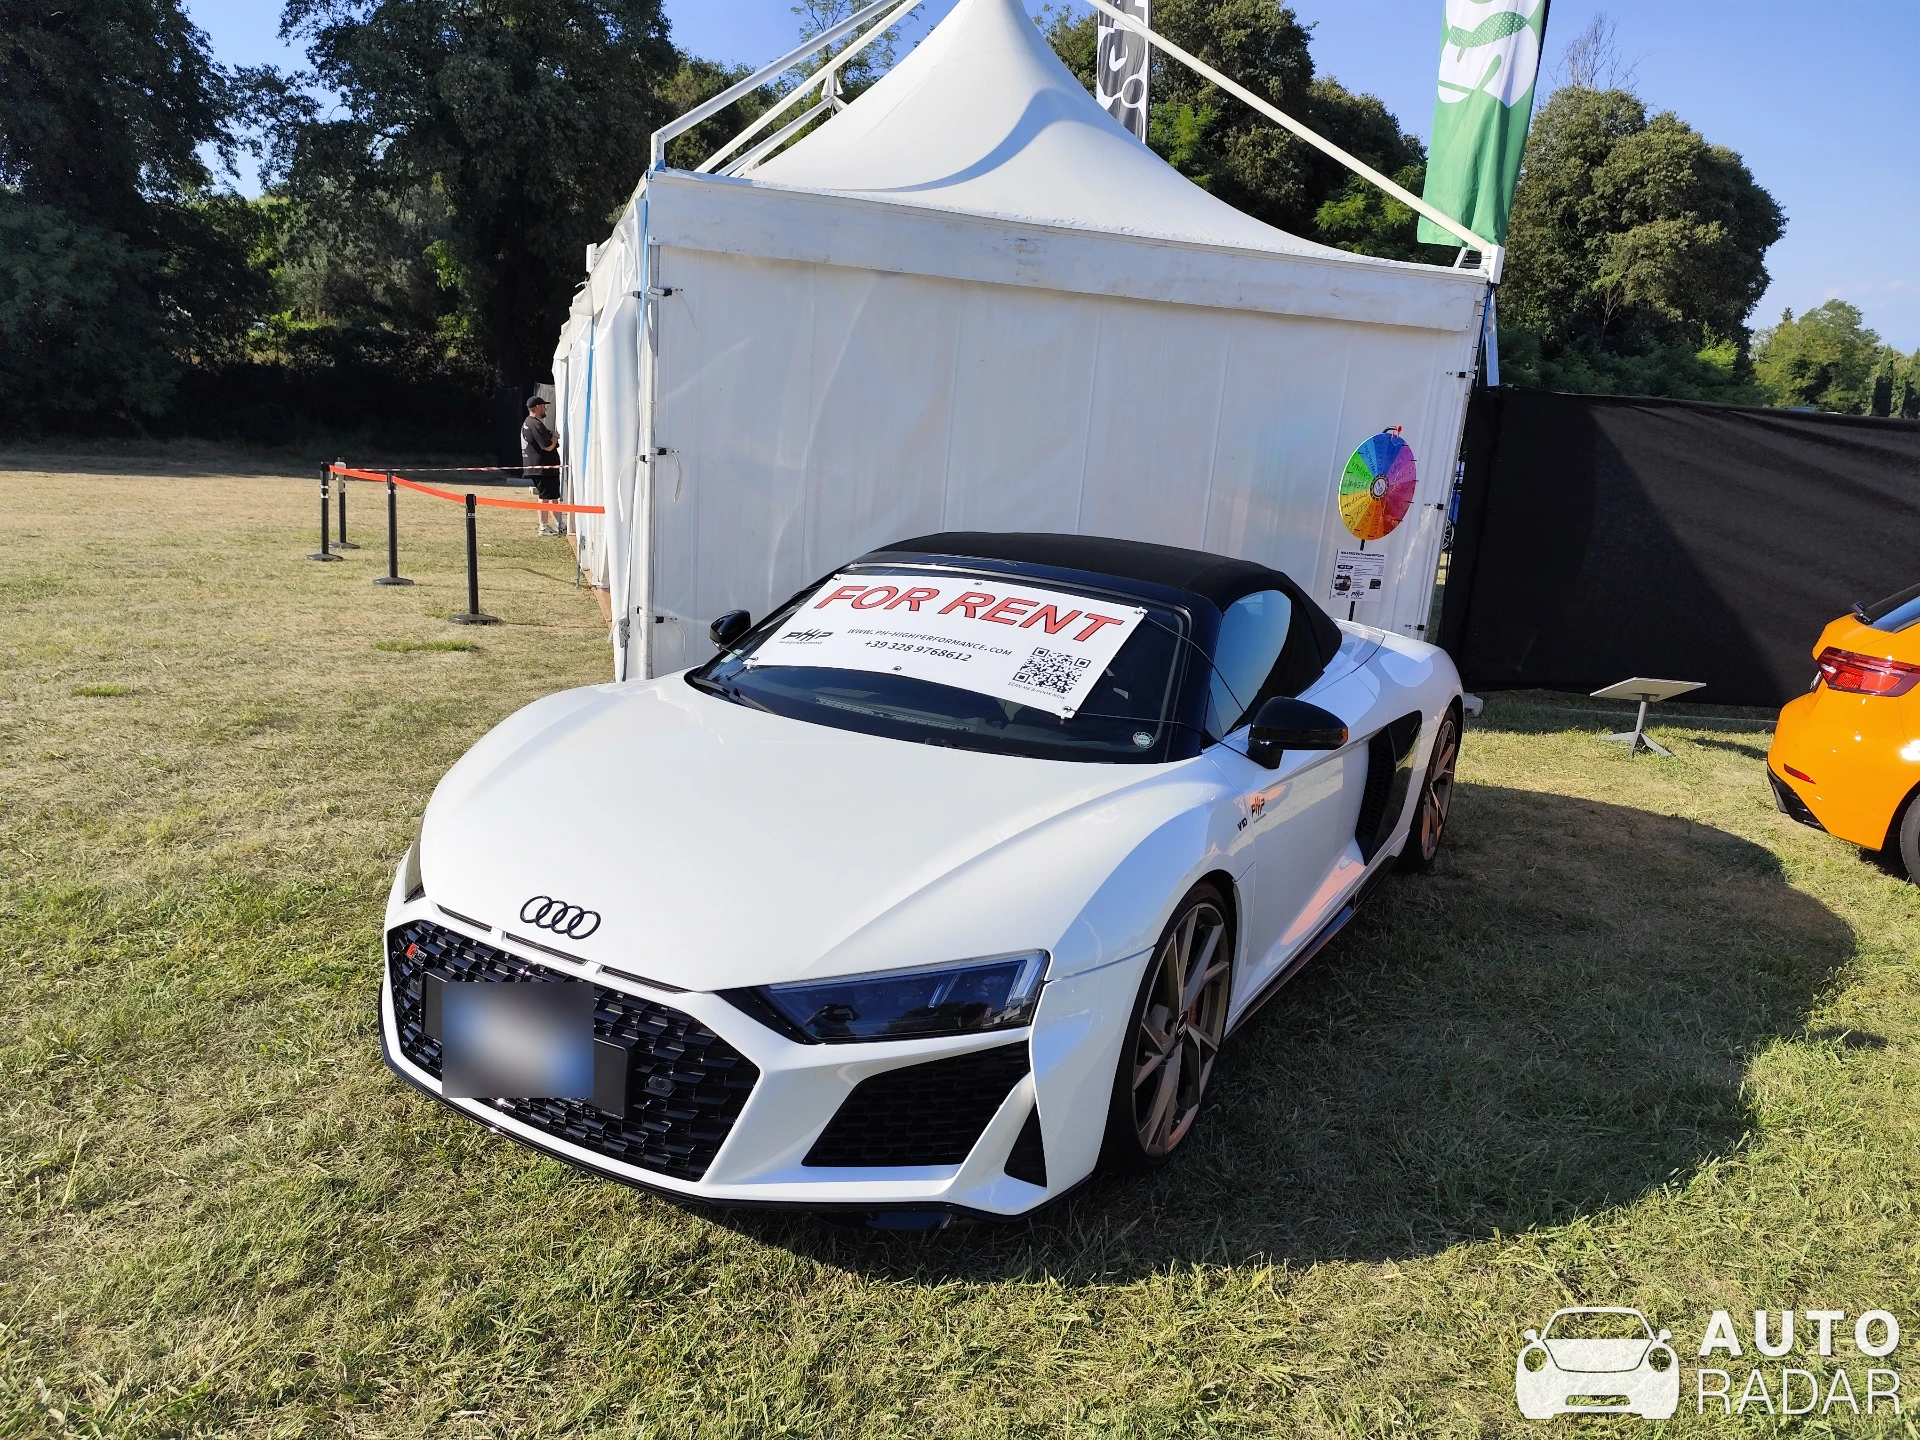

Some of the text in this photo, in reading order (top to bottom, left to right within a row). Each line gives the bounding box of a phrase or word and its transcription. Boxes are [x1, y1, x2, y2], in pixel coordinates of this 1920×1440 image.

[813, 585, 1125, 642] FOR RENT
[865, 640, 972, 662] +39 328 9768612
